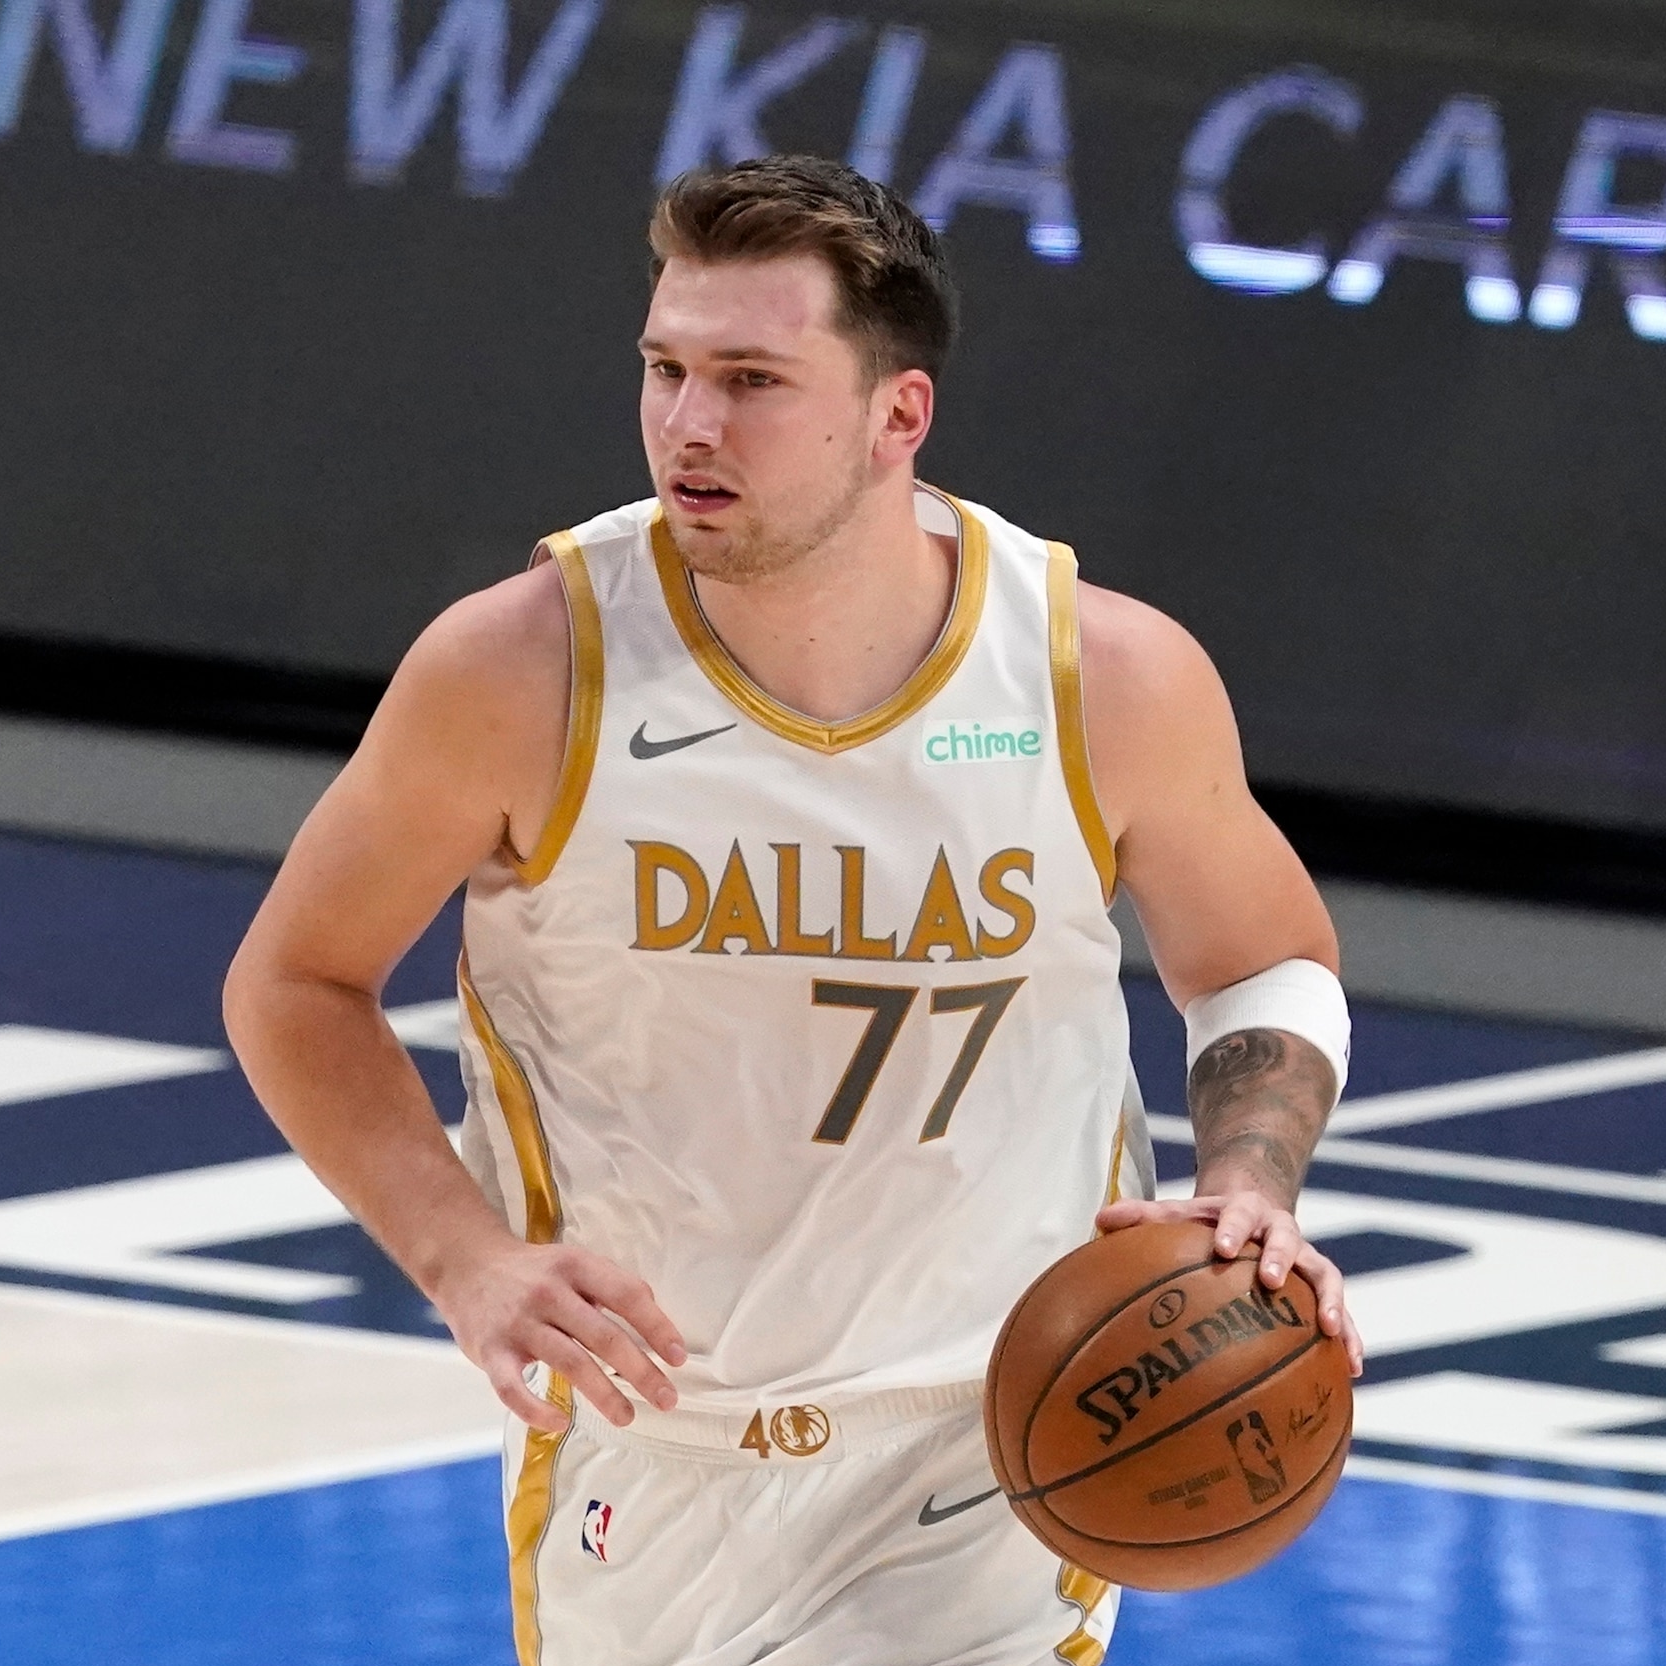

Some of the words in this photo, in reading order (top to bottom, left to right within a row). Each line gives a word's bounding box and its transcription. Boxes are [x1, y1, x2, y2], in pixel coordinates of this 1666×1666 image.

[655, 6, 1081, 262] KIA
[926, 722, 1041, 762] chime
[624, 837, 1037, 964] DALLAS
[810, 976, 1029, 1146] 77
[1075, 1285, 1304, 1446] SPALDING
